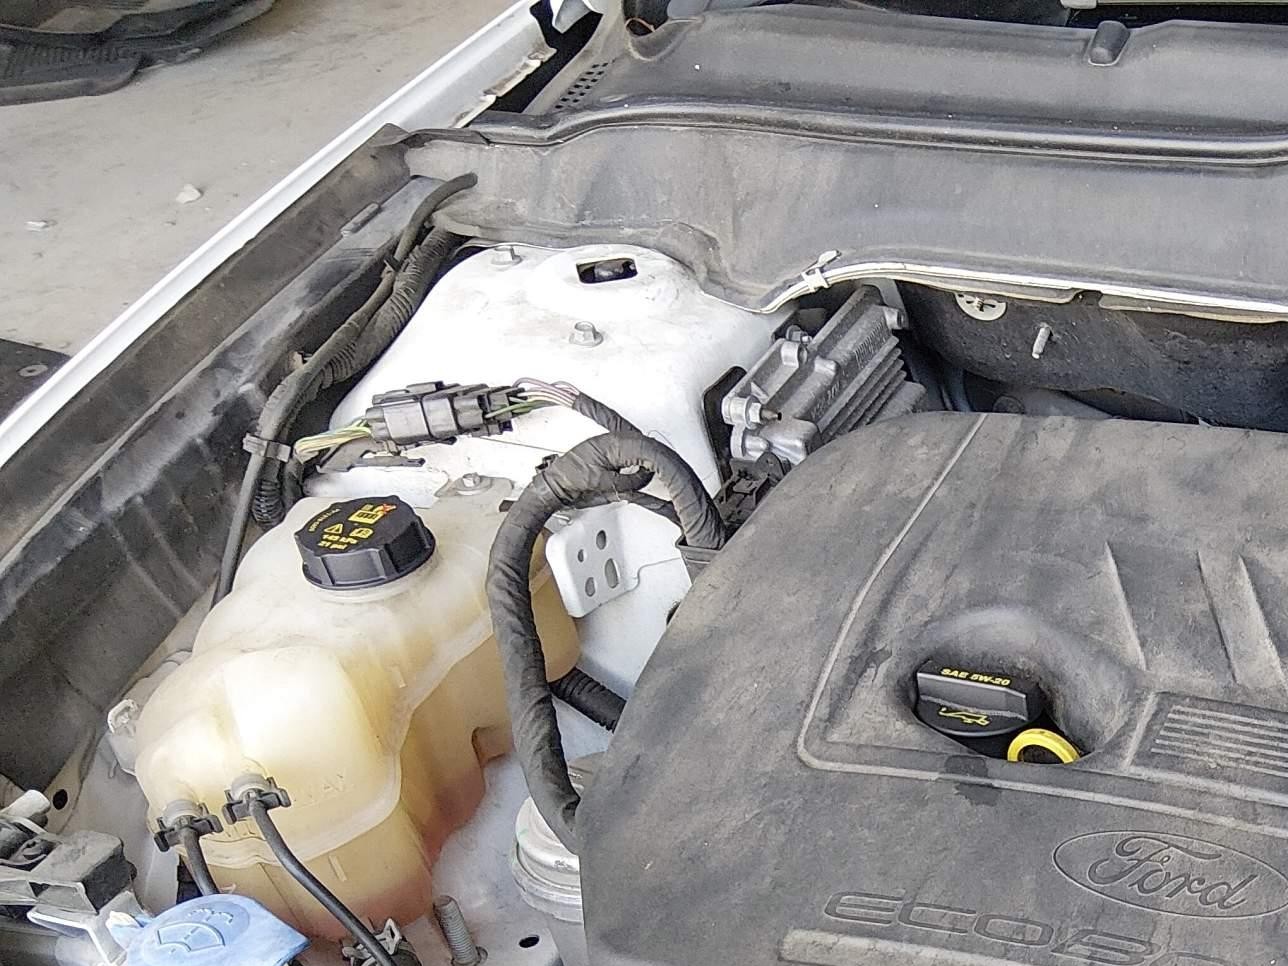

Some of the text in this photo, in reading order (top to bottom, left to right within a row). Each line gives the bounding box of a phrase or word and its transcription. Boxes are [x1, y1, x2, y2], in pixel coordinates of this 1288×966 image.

[941, 668, 1011, 686] SAE 5W-20
[1087, 835, 1259, 910] Ford
